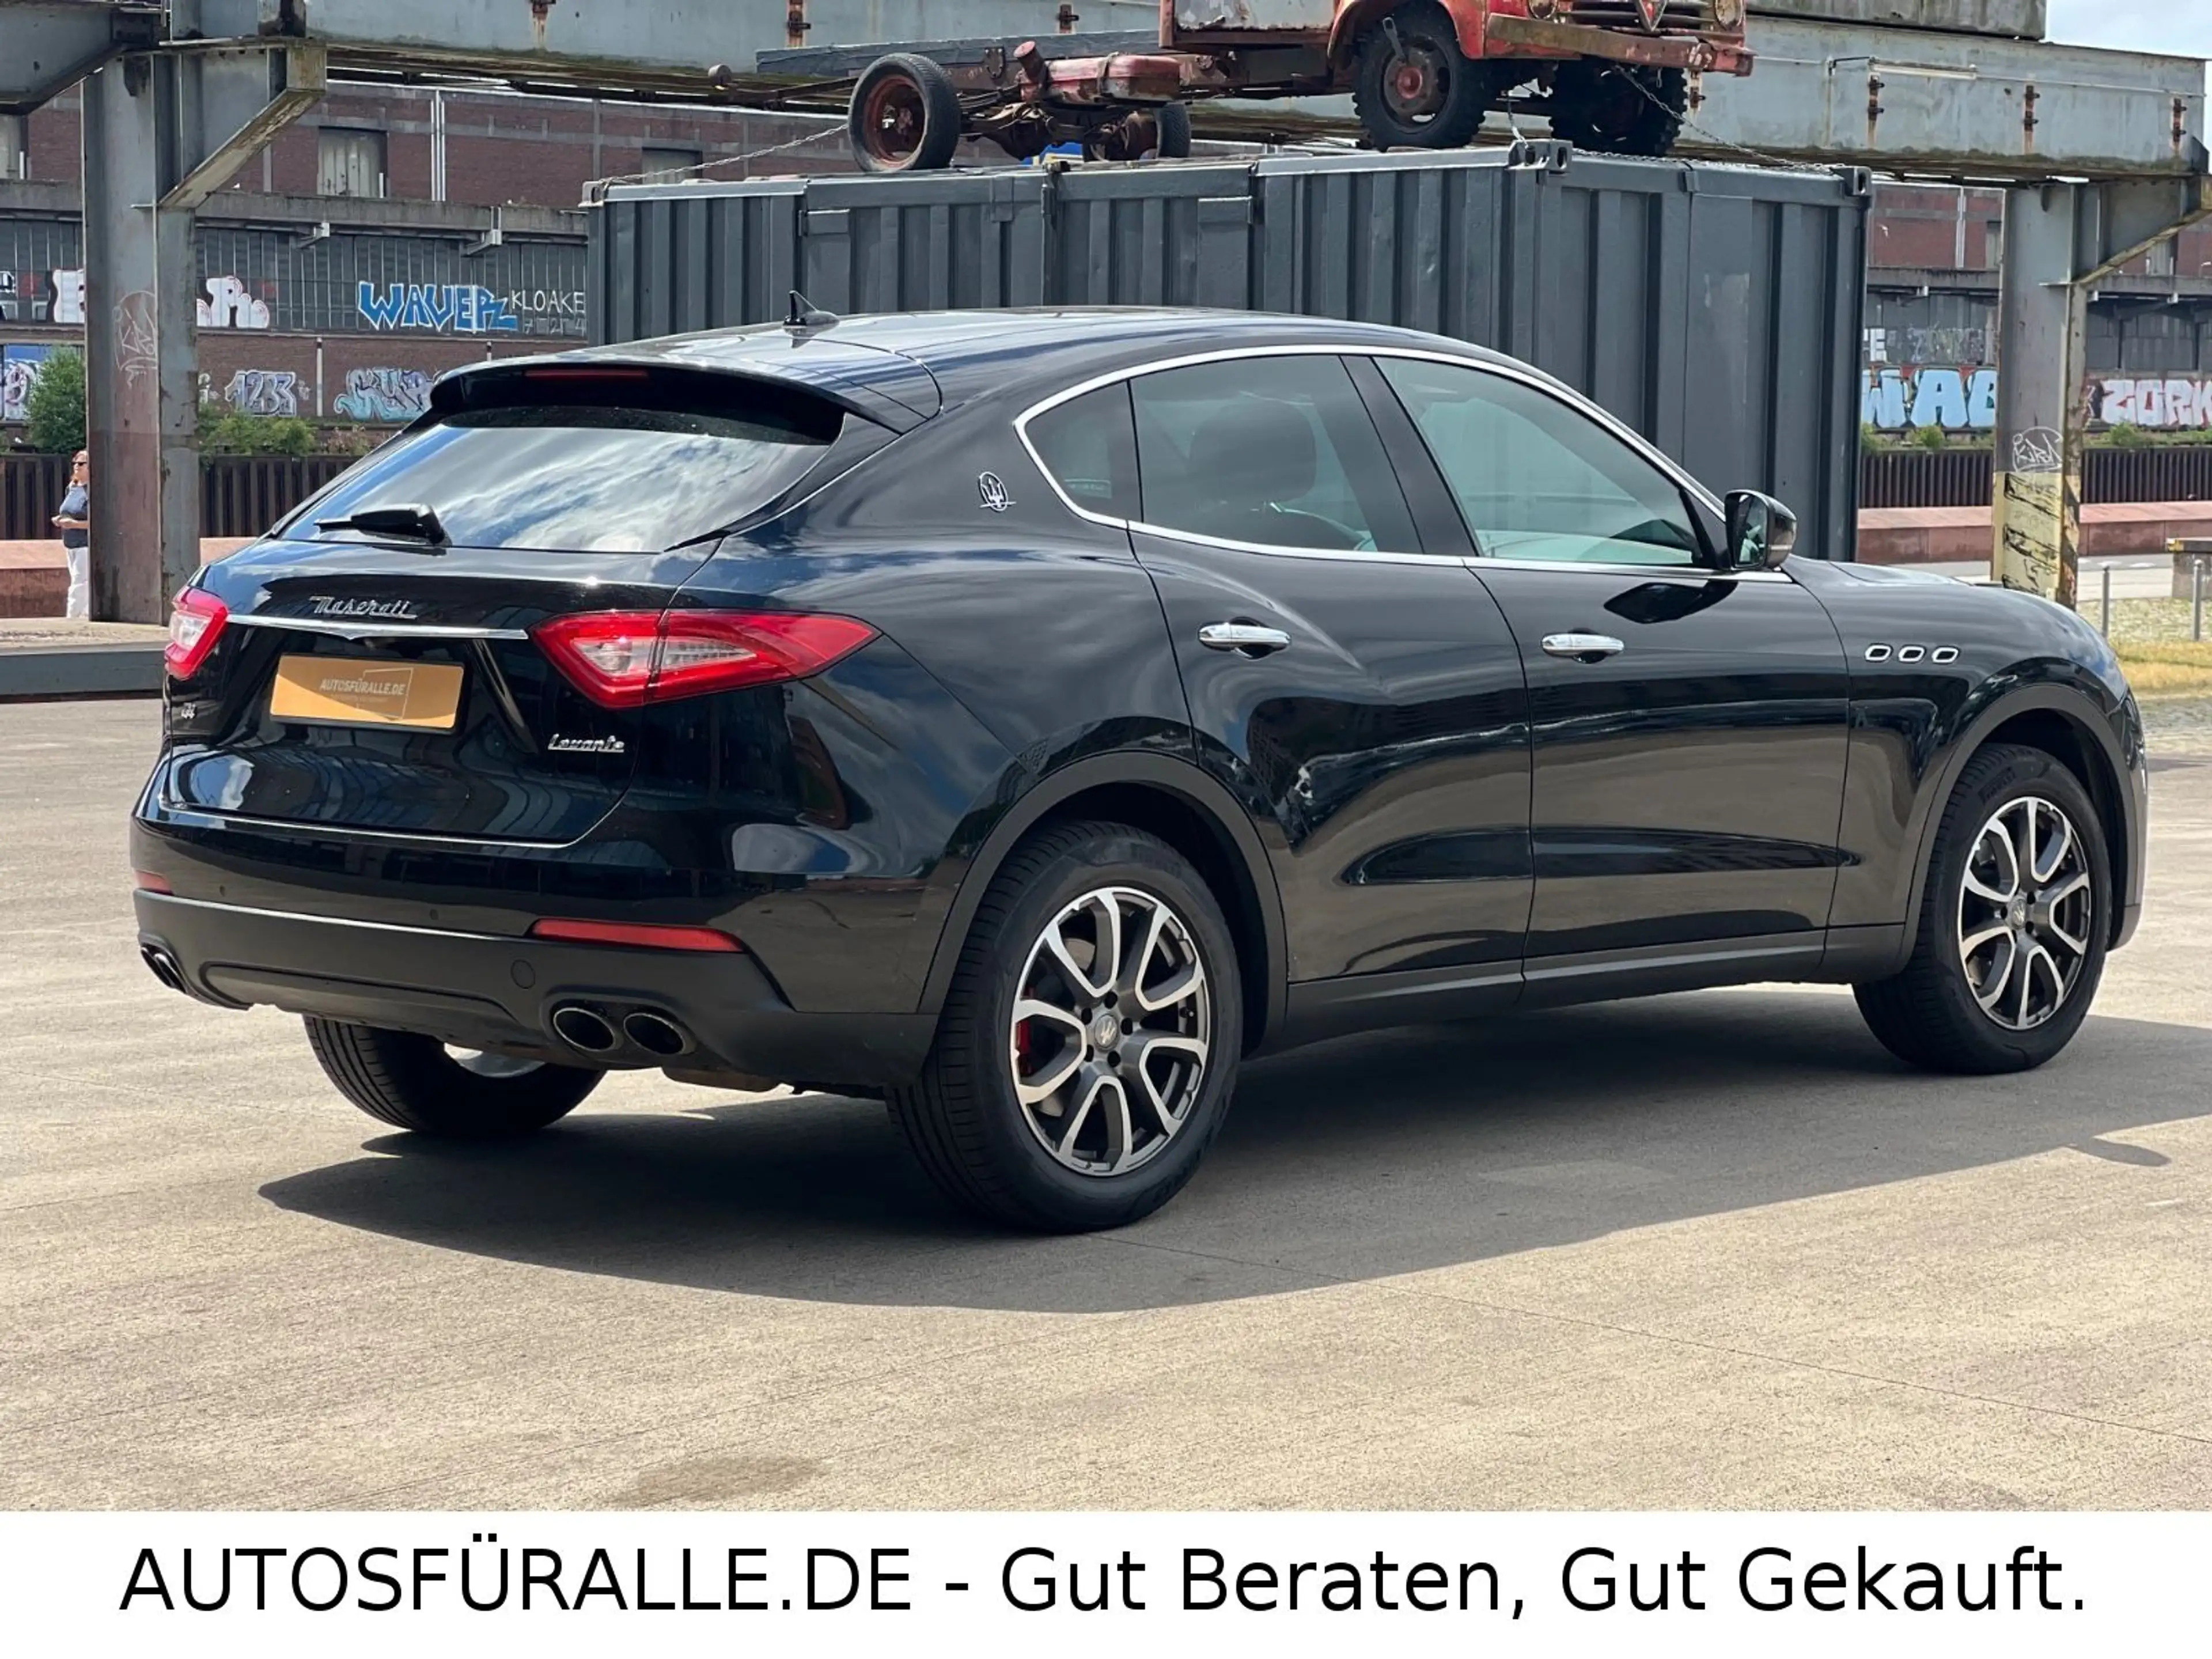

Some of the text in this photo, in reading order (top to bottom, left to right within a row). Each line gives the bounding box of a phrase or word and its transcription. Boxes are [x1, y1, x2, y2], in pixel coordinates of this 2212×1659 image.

[512, 289, 586, 314] KLOAKE
[309, 596, 418, 620] Maserati
[319, 677, 406, 696] AUTOSFÜRALLE.DE
